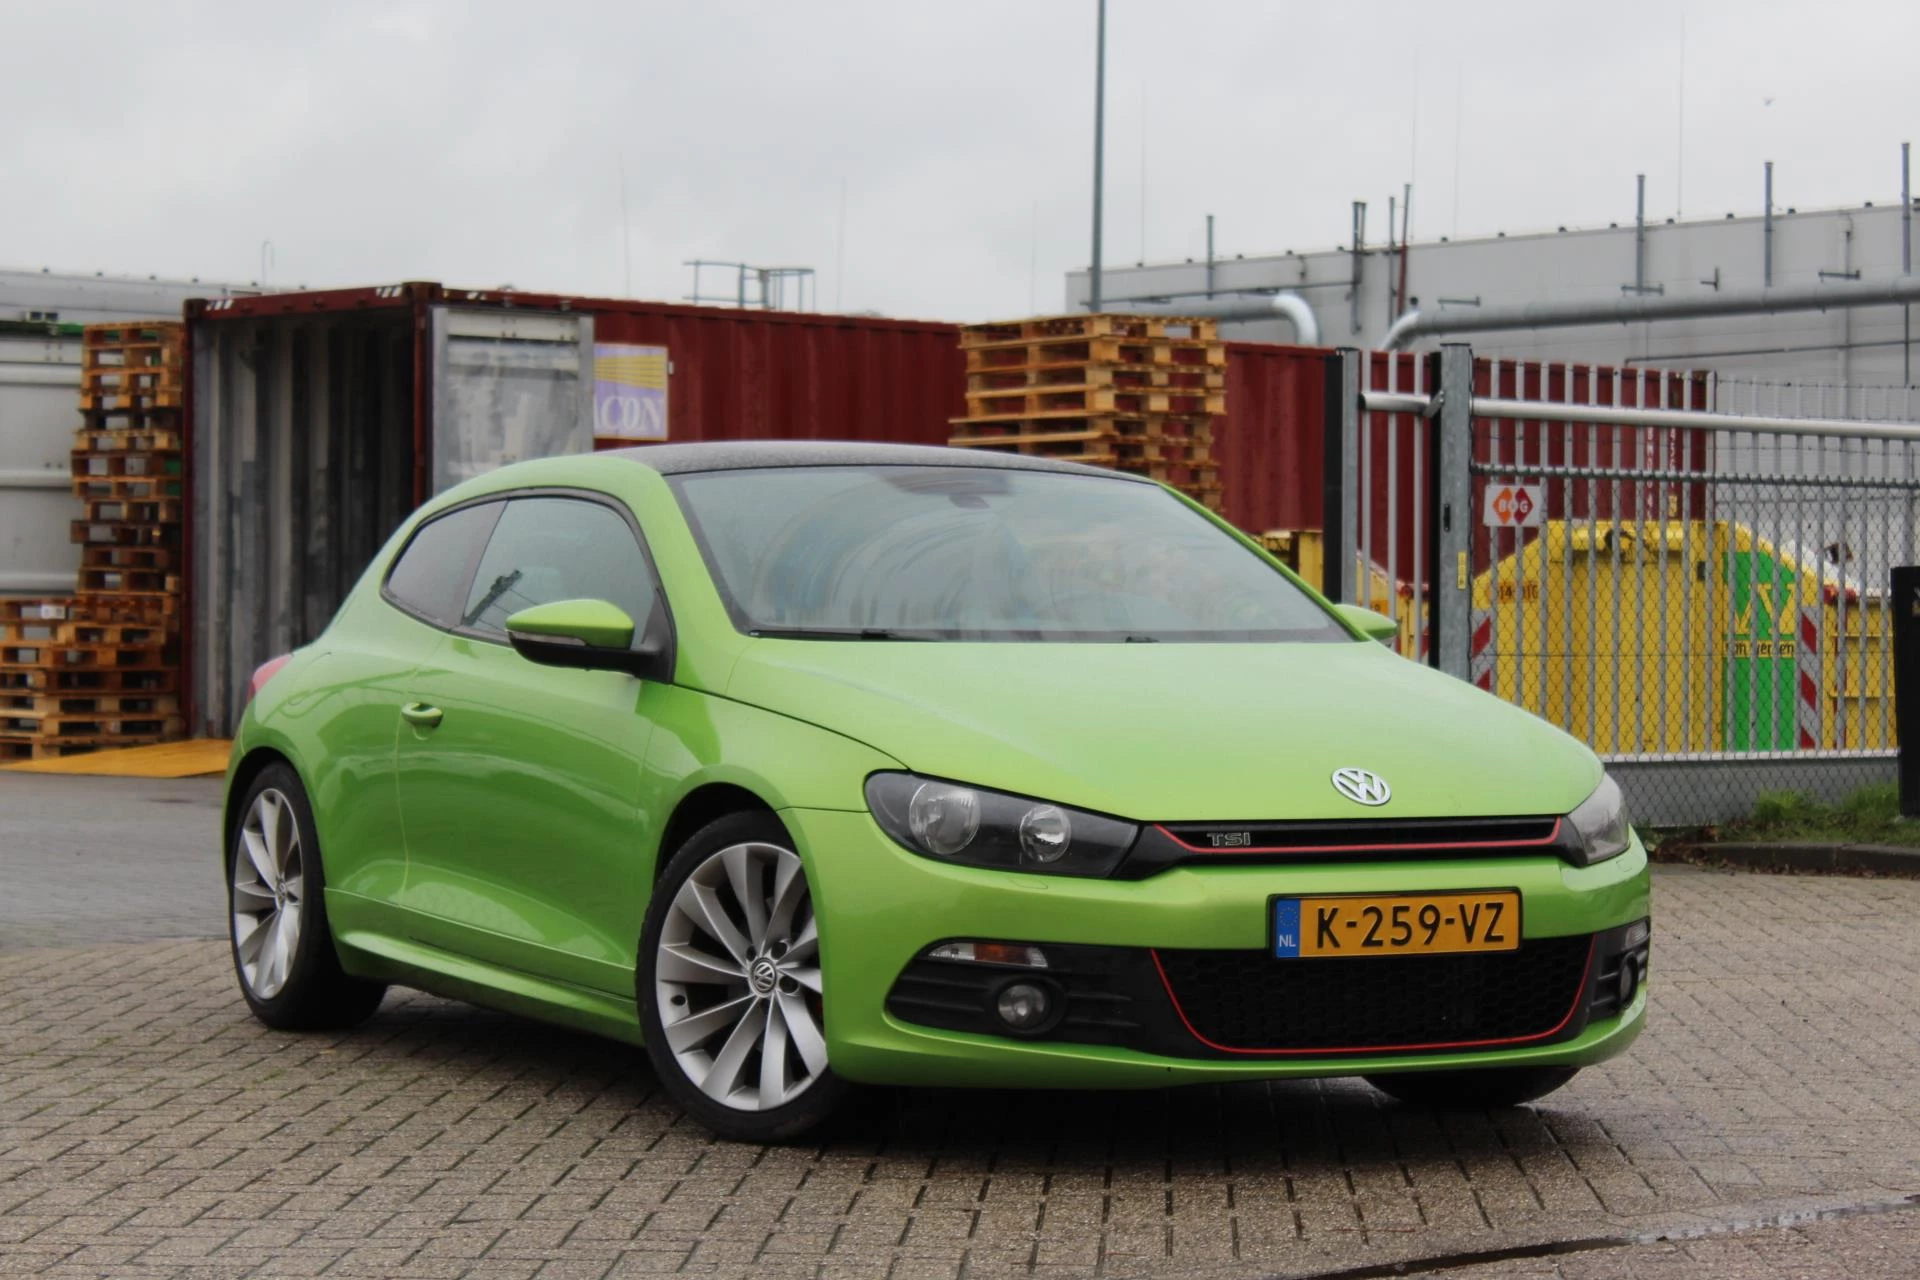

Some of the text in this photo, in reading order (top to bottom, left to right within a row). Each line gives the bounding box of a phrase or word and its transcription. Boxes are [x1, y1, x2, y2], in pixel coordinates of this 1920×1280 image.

[593, 395, 665, 432] CON
[1206, 832, 1251, 847] TSI
[1278, 902, 1505, 949] NL K-259-VZ
